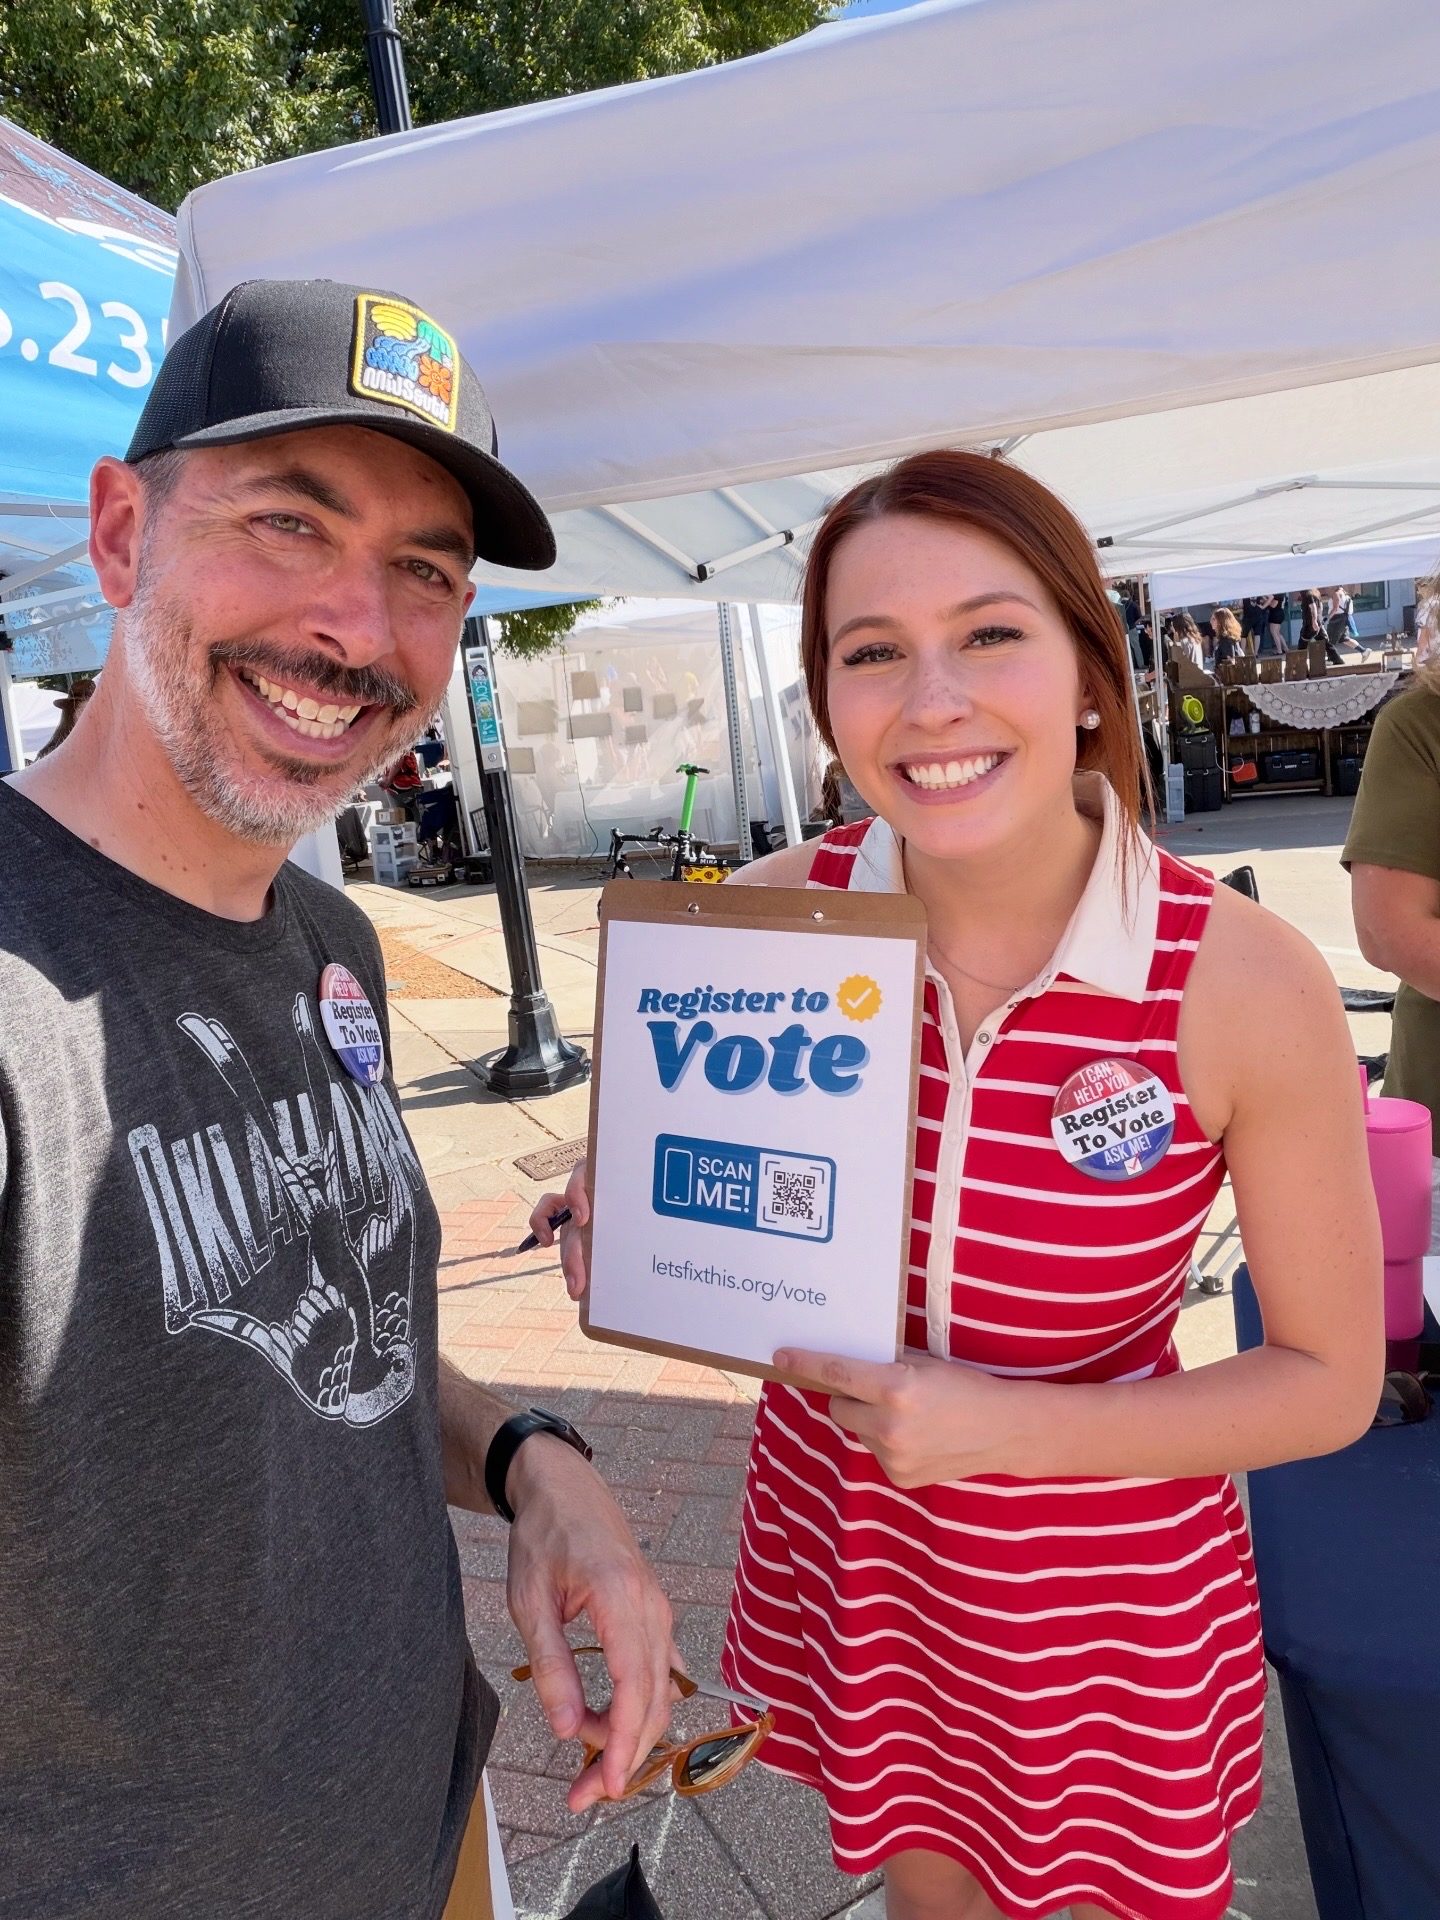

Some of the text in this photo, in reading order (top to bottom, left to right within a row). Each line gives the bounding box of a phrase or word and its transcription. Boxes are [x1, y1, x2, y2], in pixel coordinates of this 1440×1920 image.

[0, 281, 168, 388] .23
[637, 984, 829, 1020] Register to
[339, 1024, 380, 1045] To Vote
[357, 1047, 369, 1064] ASK
[646, 1020, 870, 1097] Vote
[1073, 1072, 1130, 1106] HELP YOU
[1078, 1061, 1113, 1086] I CAN
[1060, 1085, 1158, 1135] Register
[1072, 1110, 1165, 1155] To Vote
[1104, 1134, 1152, 1166] ASK ME!
[698, 1156, 752, 1181] SCAN
[696, 1179, 750, 1213] ME!
[652, 1254, 828, 1307] letsfixthis.org/vote
